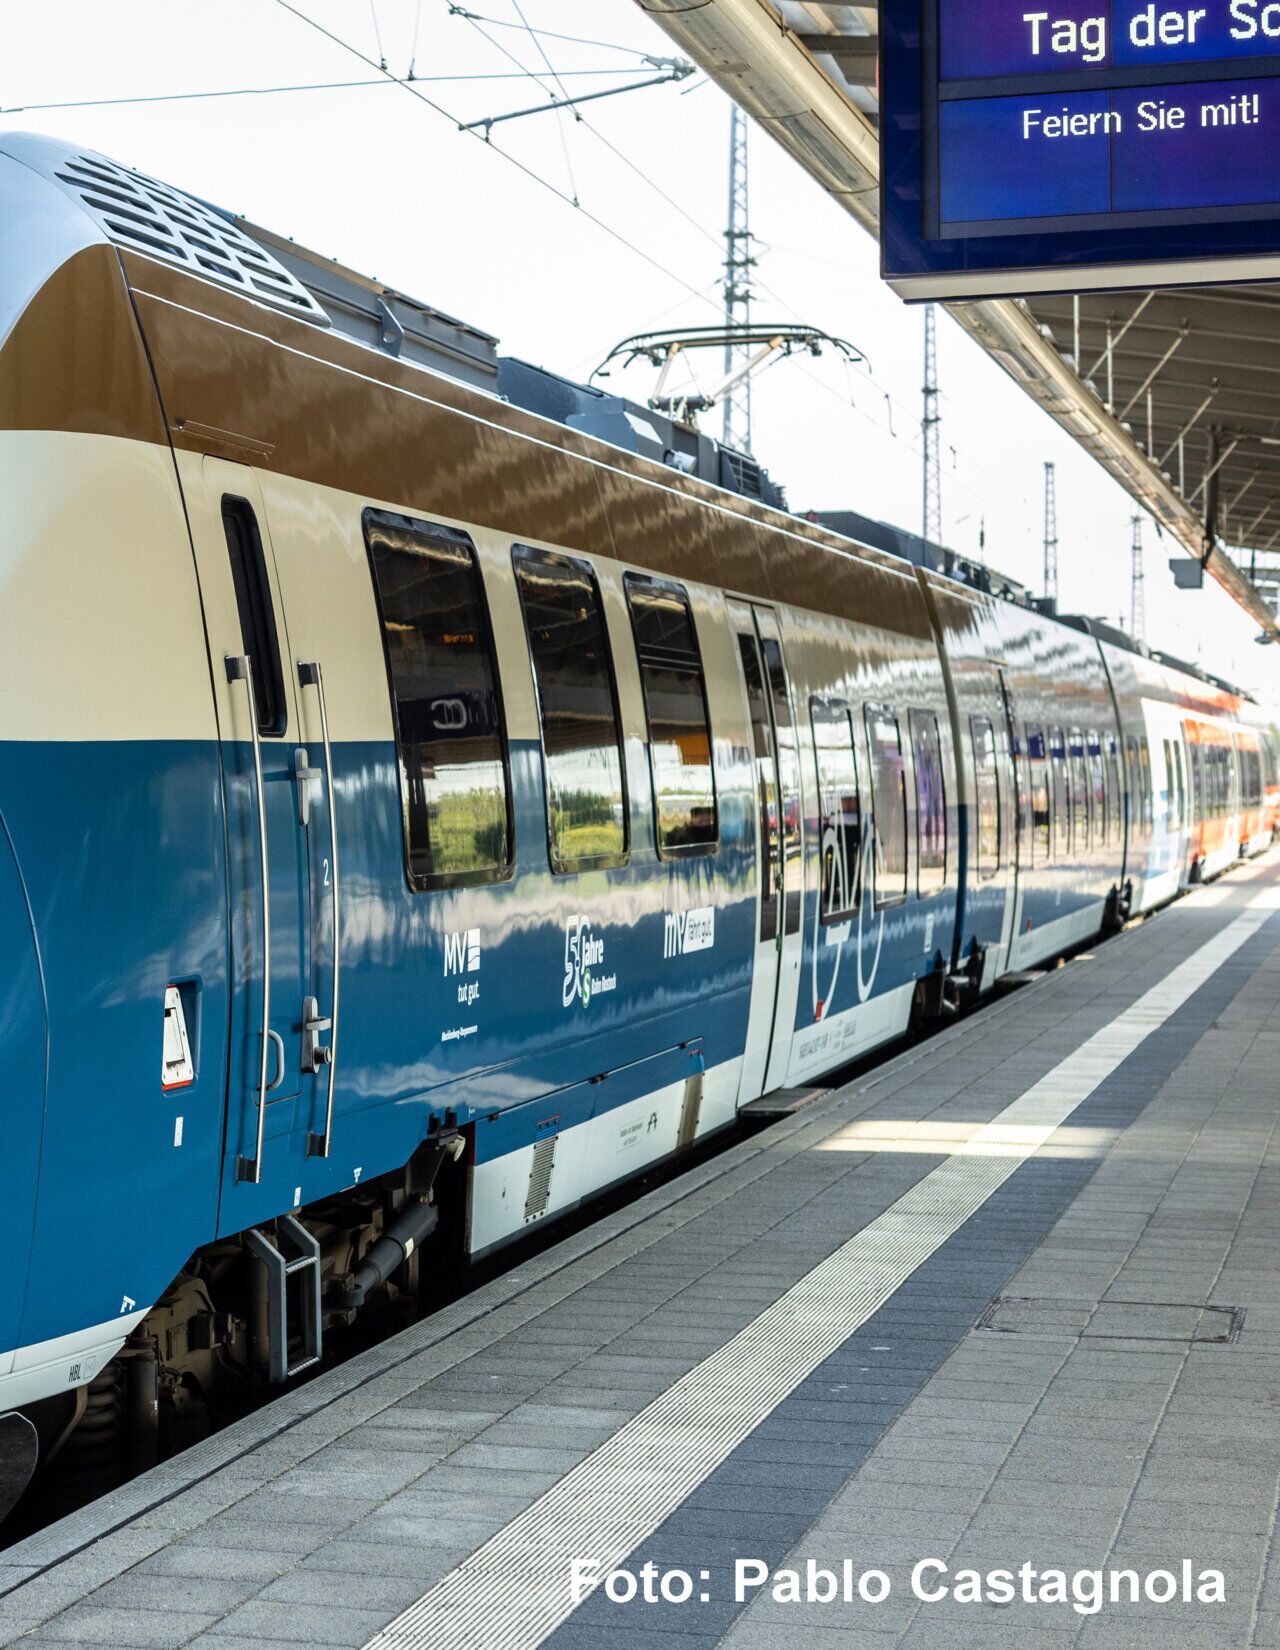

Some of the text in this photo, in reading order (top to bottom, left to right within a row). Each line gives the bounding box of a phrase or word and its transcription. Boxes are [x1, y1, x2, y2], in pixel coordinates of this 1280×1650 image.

[1023, 12, 1107, 62] Tag
[1129, 4, 1206, 47] der
[1022, 94, 1260, 139] Feiern Sie mit!
[323, 858, 329, 886] 2
[444, 930, 468, 977] MV
